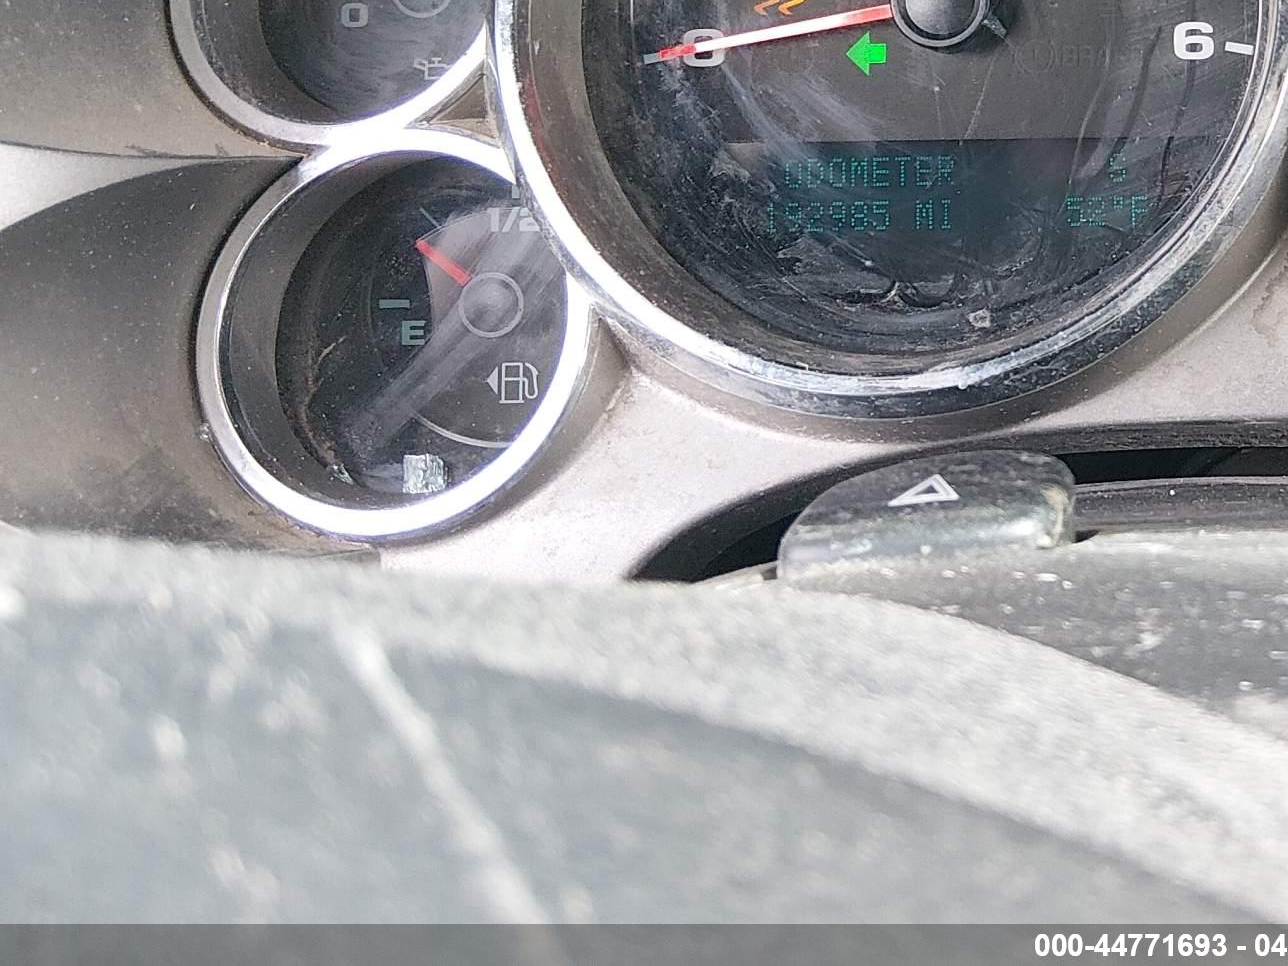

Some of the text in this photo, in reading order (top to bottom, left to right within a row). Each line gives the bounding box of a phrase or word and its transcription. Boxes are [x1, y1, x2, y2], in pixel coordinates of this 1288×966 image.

[341, 3, 369, 28] 0
[683, 28, 725, 67] 0
[1173, 21, 1214, 60] 6
[785, 157, 955, 188] ODOMETER
[915, 199, 951, 230] MI
[401, 320, 426, 345] E
